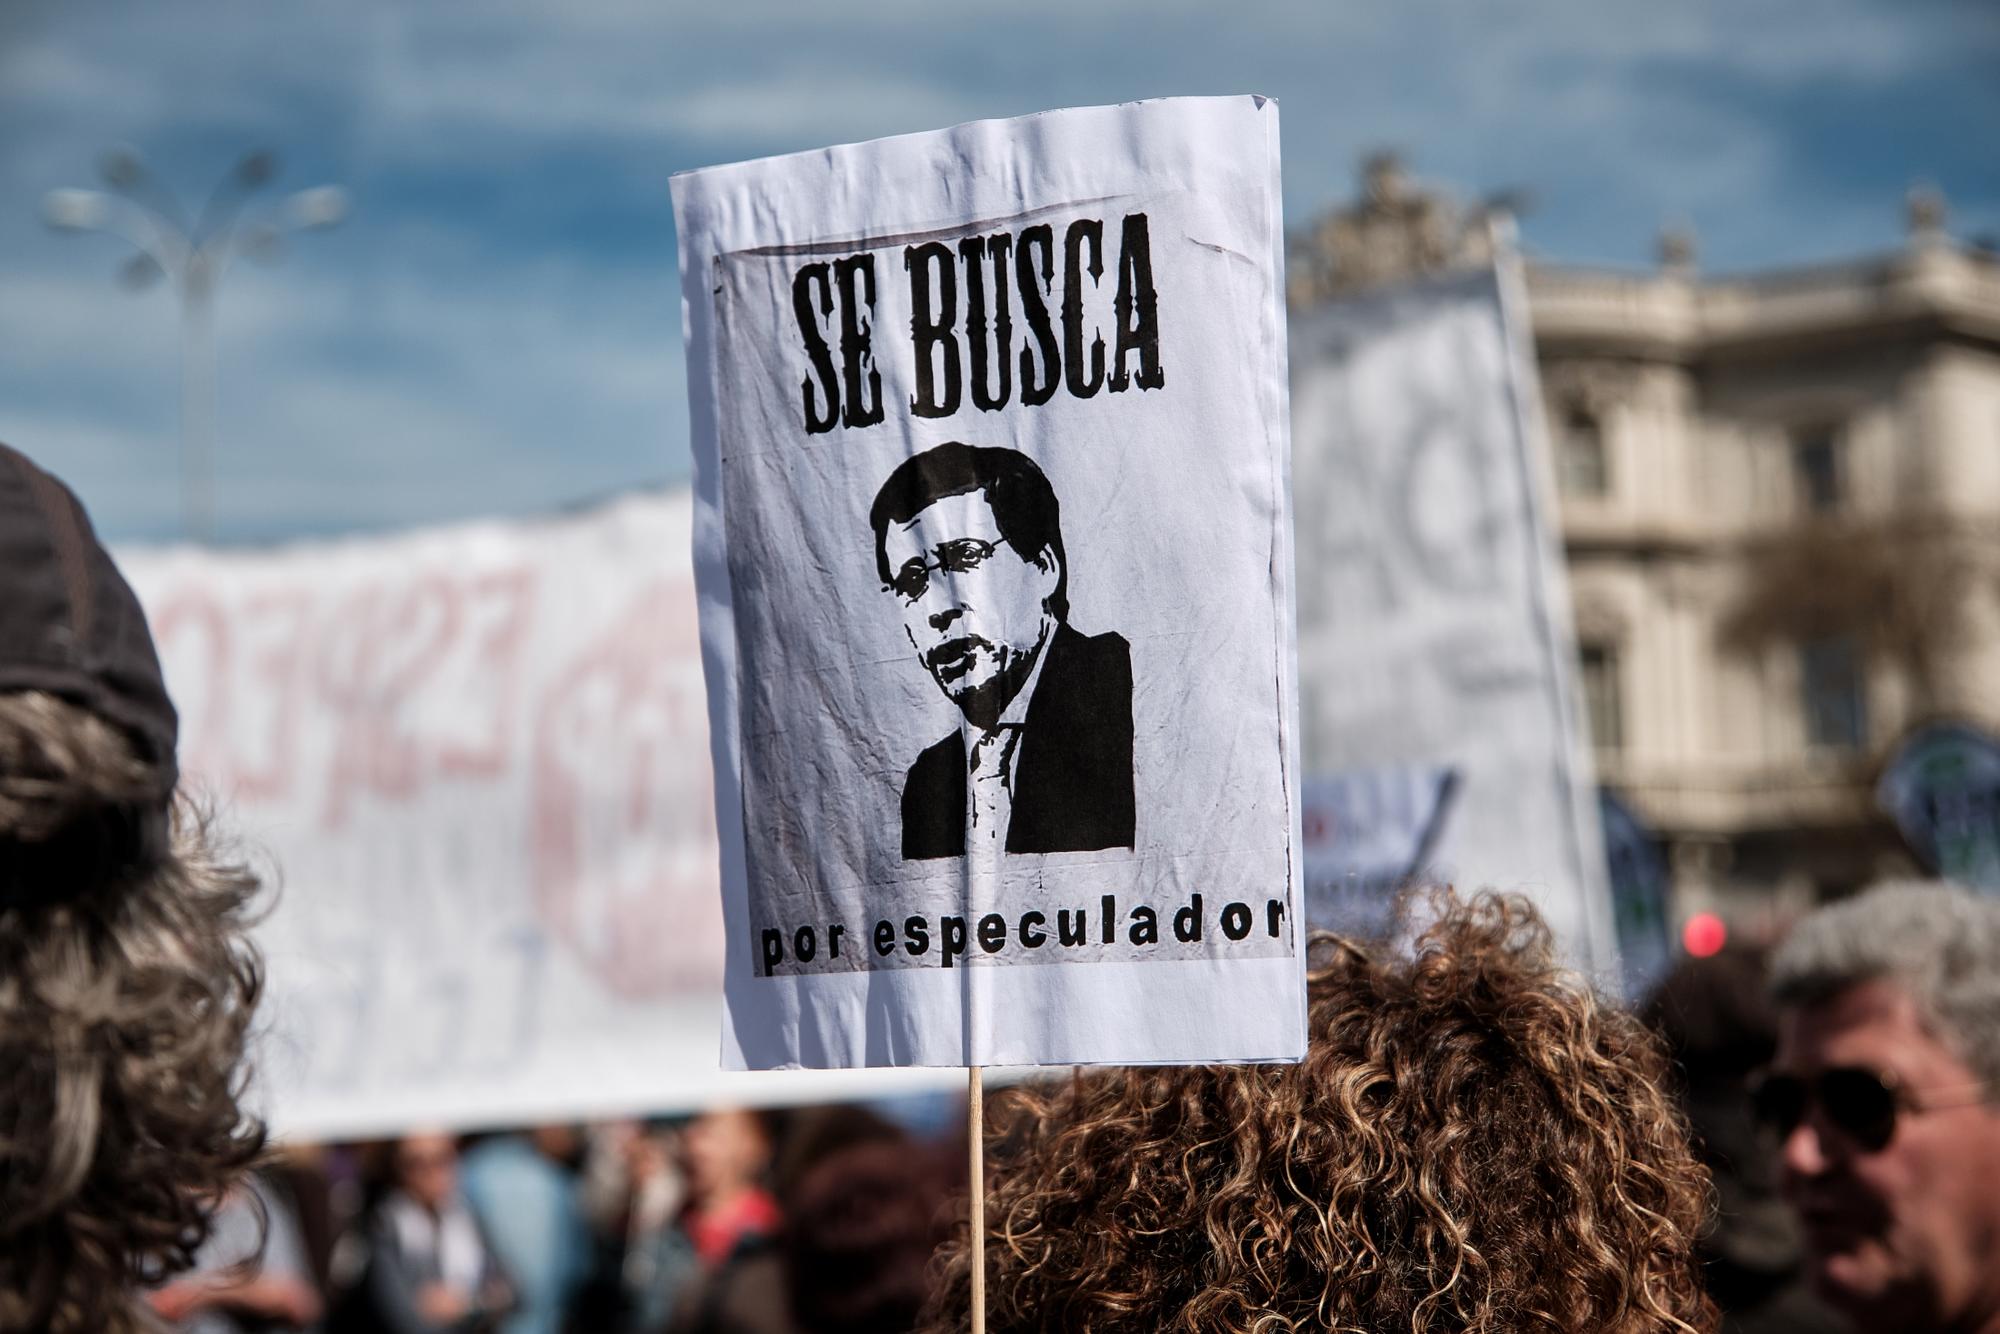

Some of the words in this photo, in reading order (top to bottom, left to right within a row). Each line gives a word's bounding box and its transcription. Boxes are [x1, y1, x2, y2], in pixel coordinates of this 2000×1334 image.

[792, 253, 885, 435] SE
[904, 212, 1164, 418] BUSCA
[761, 922, 845, 977] por
[874, 893, 1286, 968] especulador
